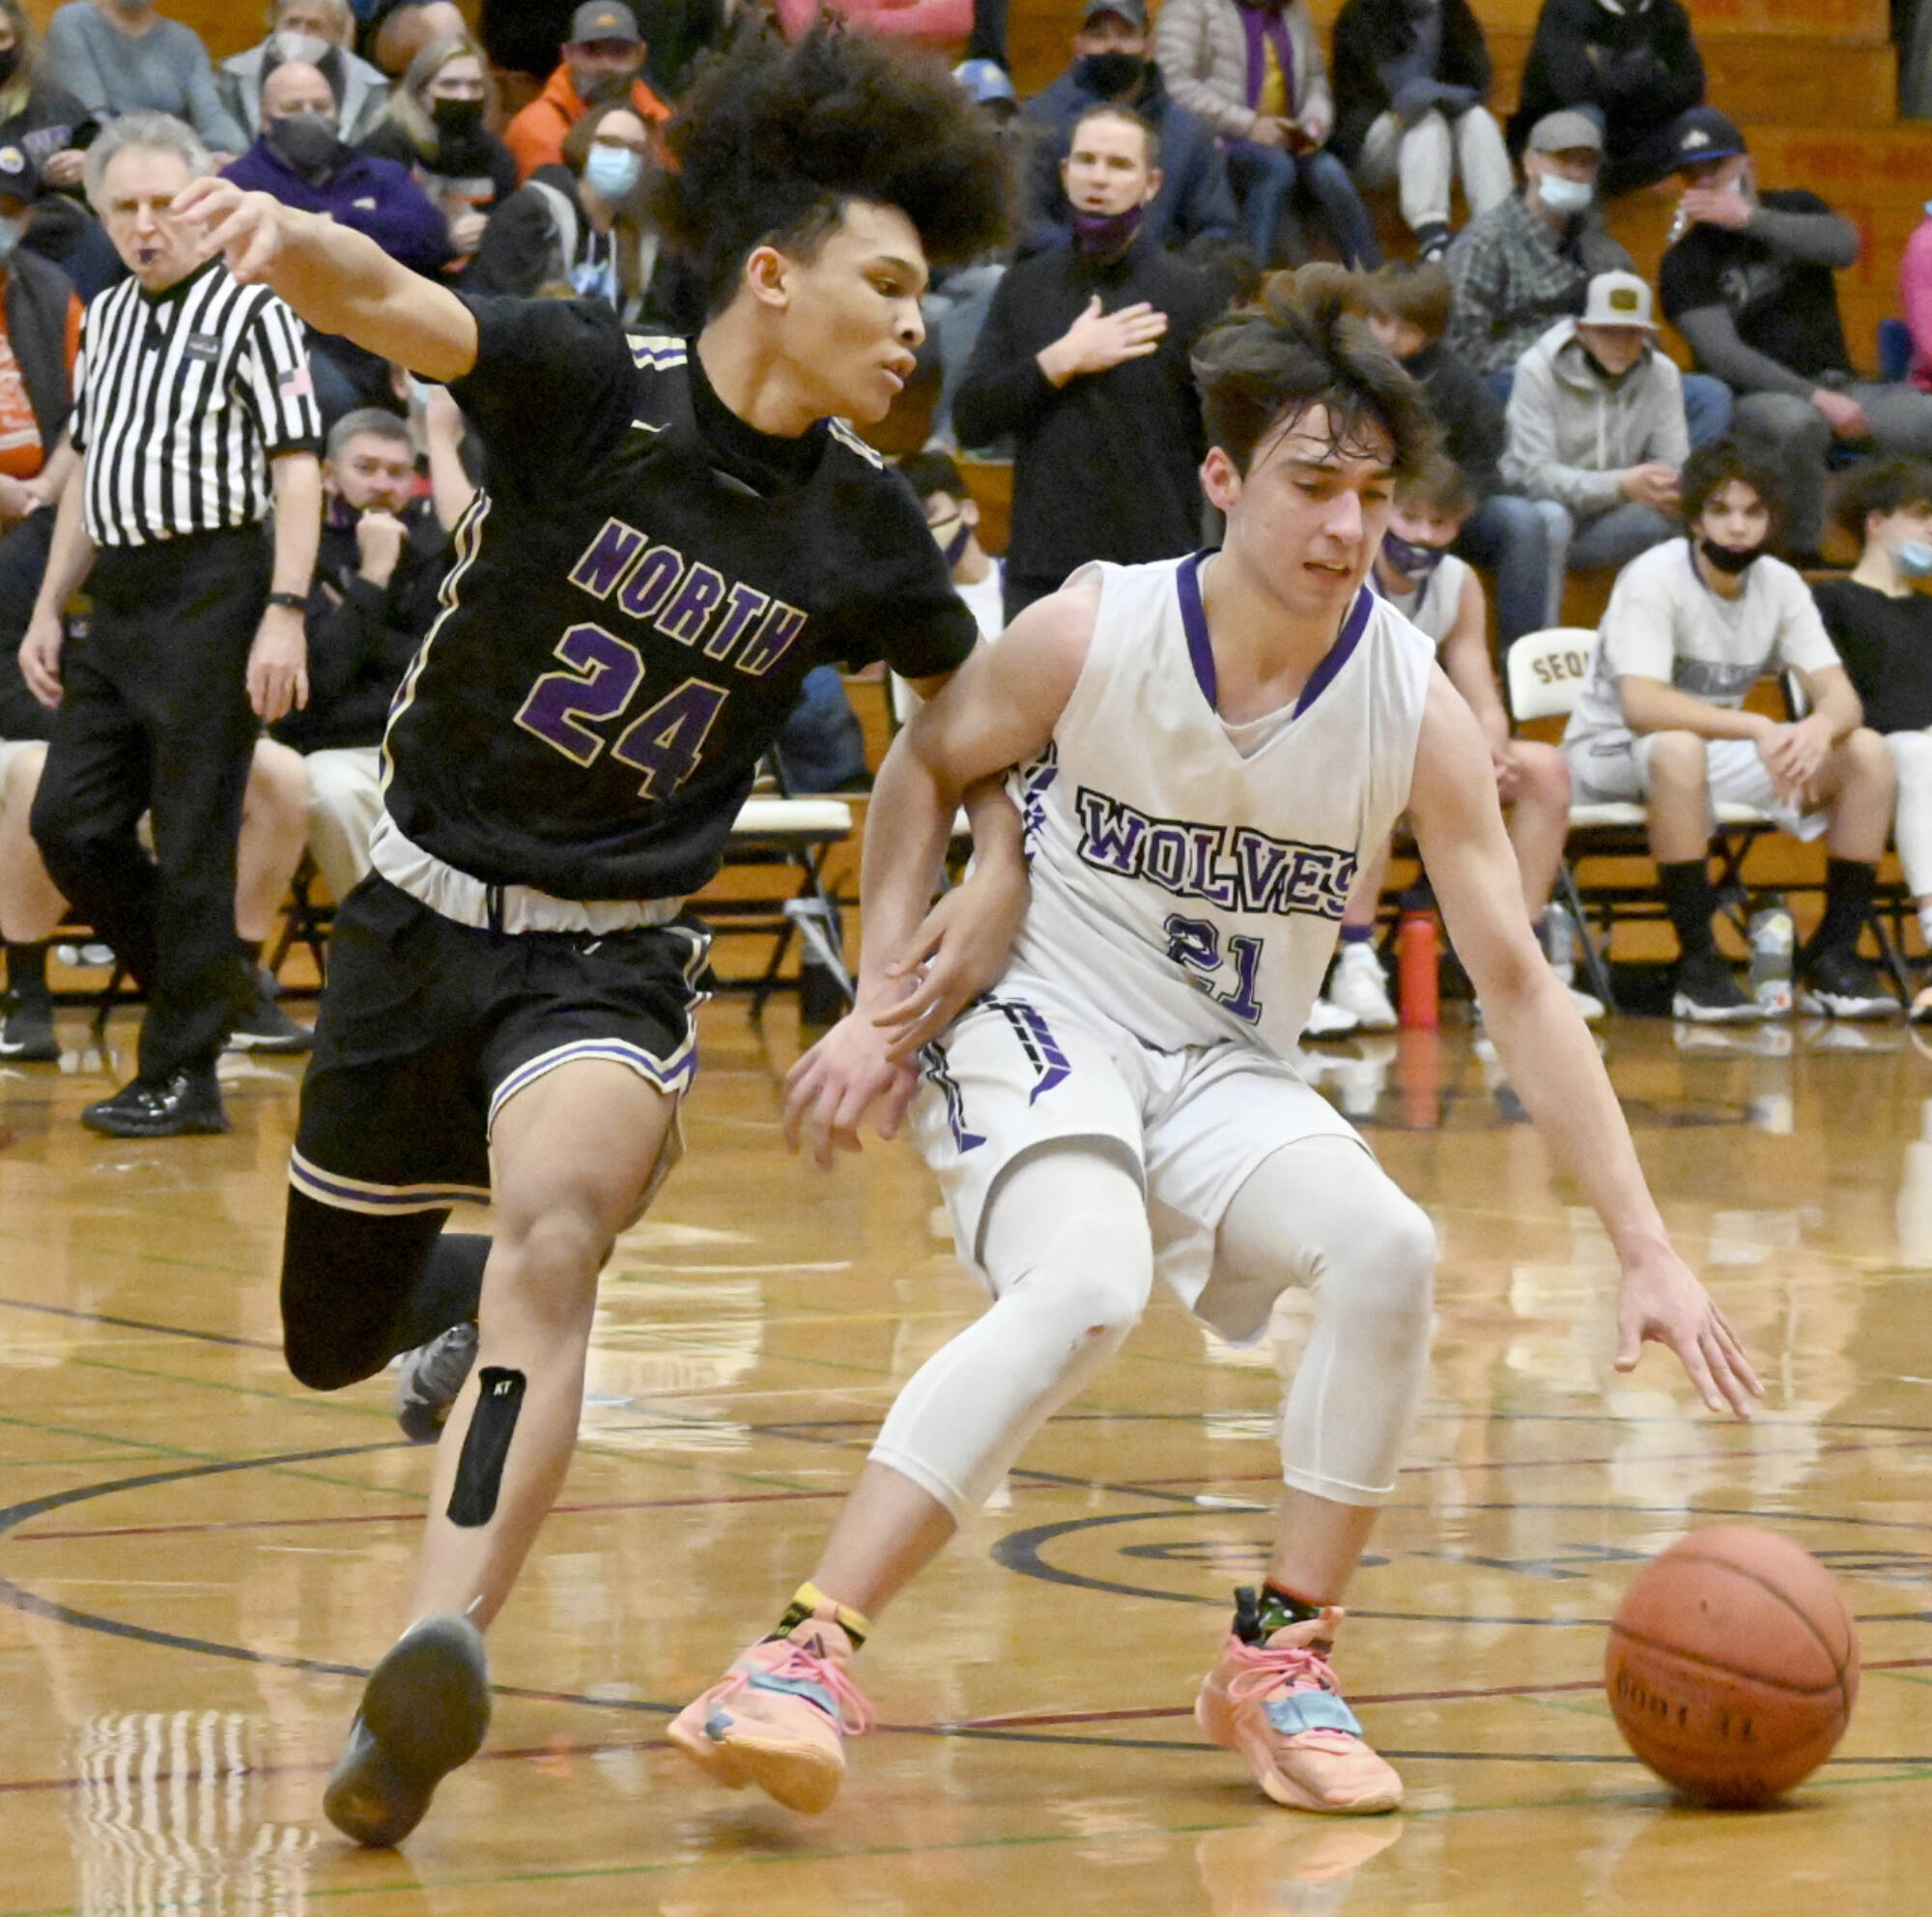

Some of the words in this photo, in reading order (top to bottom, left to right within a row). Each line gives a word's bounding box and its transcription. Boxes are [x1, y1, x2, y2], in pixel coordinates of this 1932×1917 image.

[567, 516, 809, 676] NORTH
[513, 621, 730, 801] 24
[1532, 650, 1590, 684] SEQ
[1075, 786, 1358, 922] WOLVES
[1163, 913, 1264, 1026] 21
[493, 1380, 513, 1396] KT
